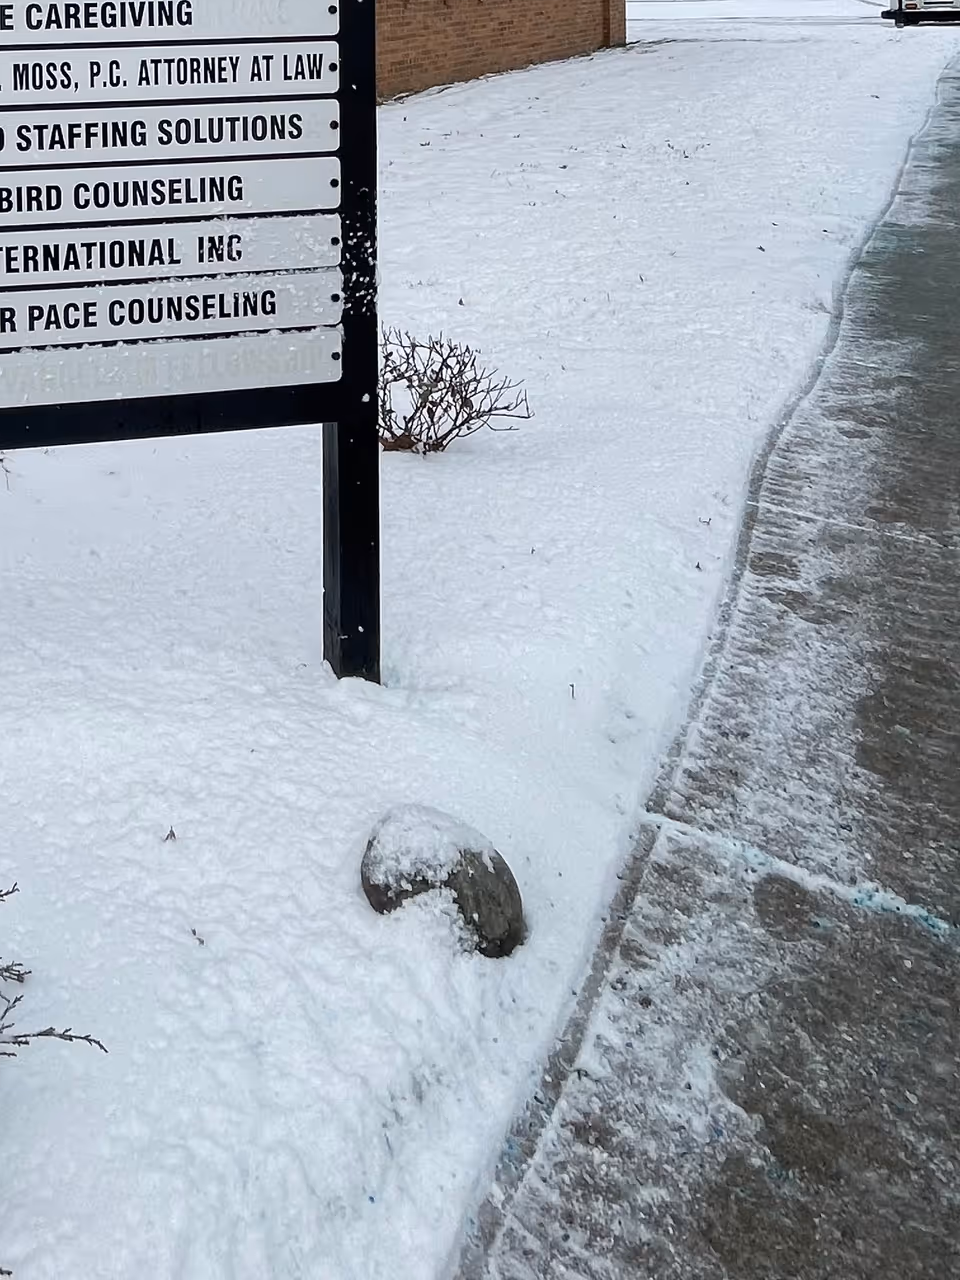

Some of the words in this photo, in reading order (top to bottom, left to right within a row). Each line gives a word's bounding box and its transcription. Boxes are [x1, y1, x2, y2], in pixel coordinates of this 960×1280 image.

[26, 0, 192, 30] CAREGIVING
[13, 62, 78, 92] MOSS,
[90, 60, 126, 87] P.C.
[138, 56, 239, 85] ATTORNEY
[250, 55, 273, 81] AT
[284, 54, 323, 80] LAW
[17, 121, 146, 151] STAFFING
[158, 114, 302, 145] SOLUTIONS
[74, 176, 244, 211] COUNSELING
[198, 235, 242, 263] INC
[29, 302, 97, 331] PACE
[109, 290, 277, 327] COUNSELING
